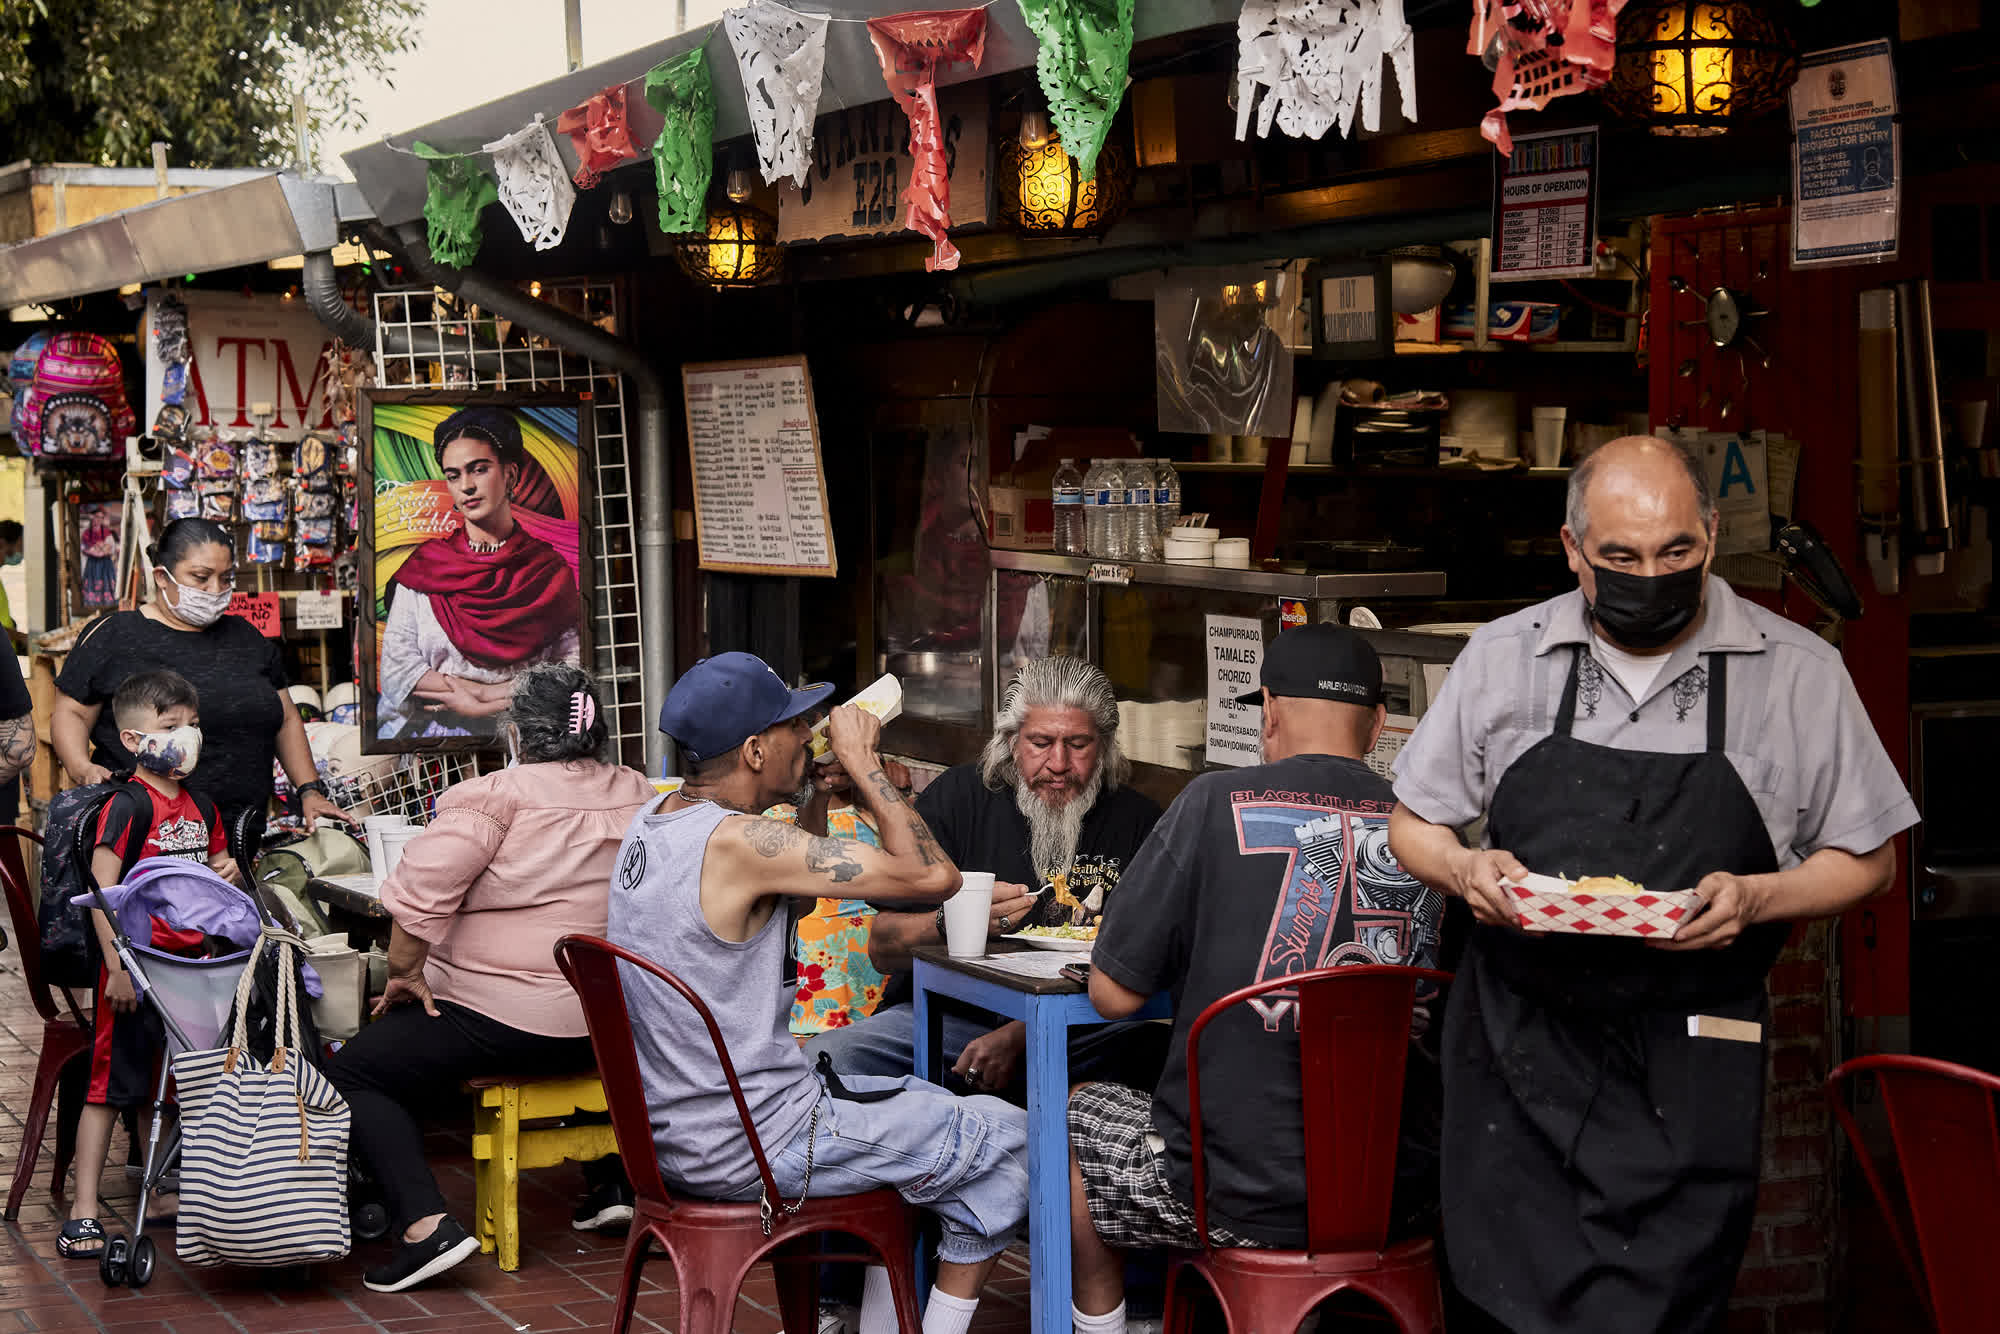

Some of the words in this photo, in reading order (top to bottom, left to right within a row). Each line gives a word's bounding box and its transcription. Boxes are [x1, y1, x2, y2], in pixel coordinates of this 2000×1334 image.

[1831, 121, 1876, 137] COVERING
[1840, 134, 1857, 145] FOR
[1858, 130, 1889, 144] ENTRY
[1504, 184, 1530, 197] HOURS
[1532, 183, 1542, 193] OF
[1544, 178, 1587, 193] OPERATION
[1719, 441, 1755, 498] A
[384, 508, 457, 533] Kahlo
[1214, 646, 1258, 665] TAMALES.
[1218, 668, 1251, 684] CHORIZO
[1228, 686, 1238, 694] CON
[1231, 790, 1311, 805] BLACK
[1315, 793, 1380, 813] HILLS
[1269, 878, 1329, 972] Sturgis
